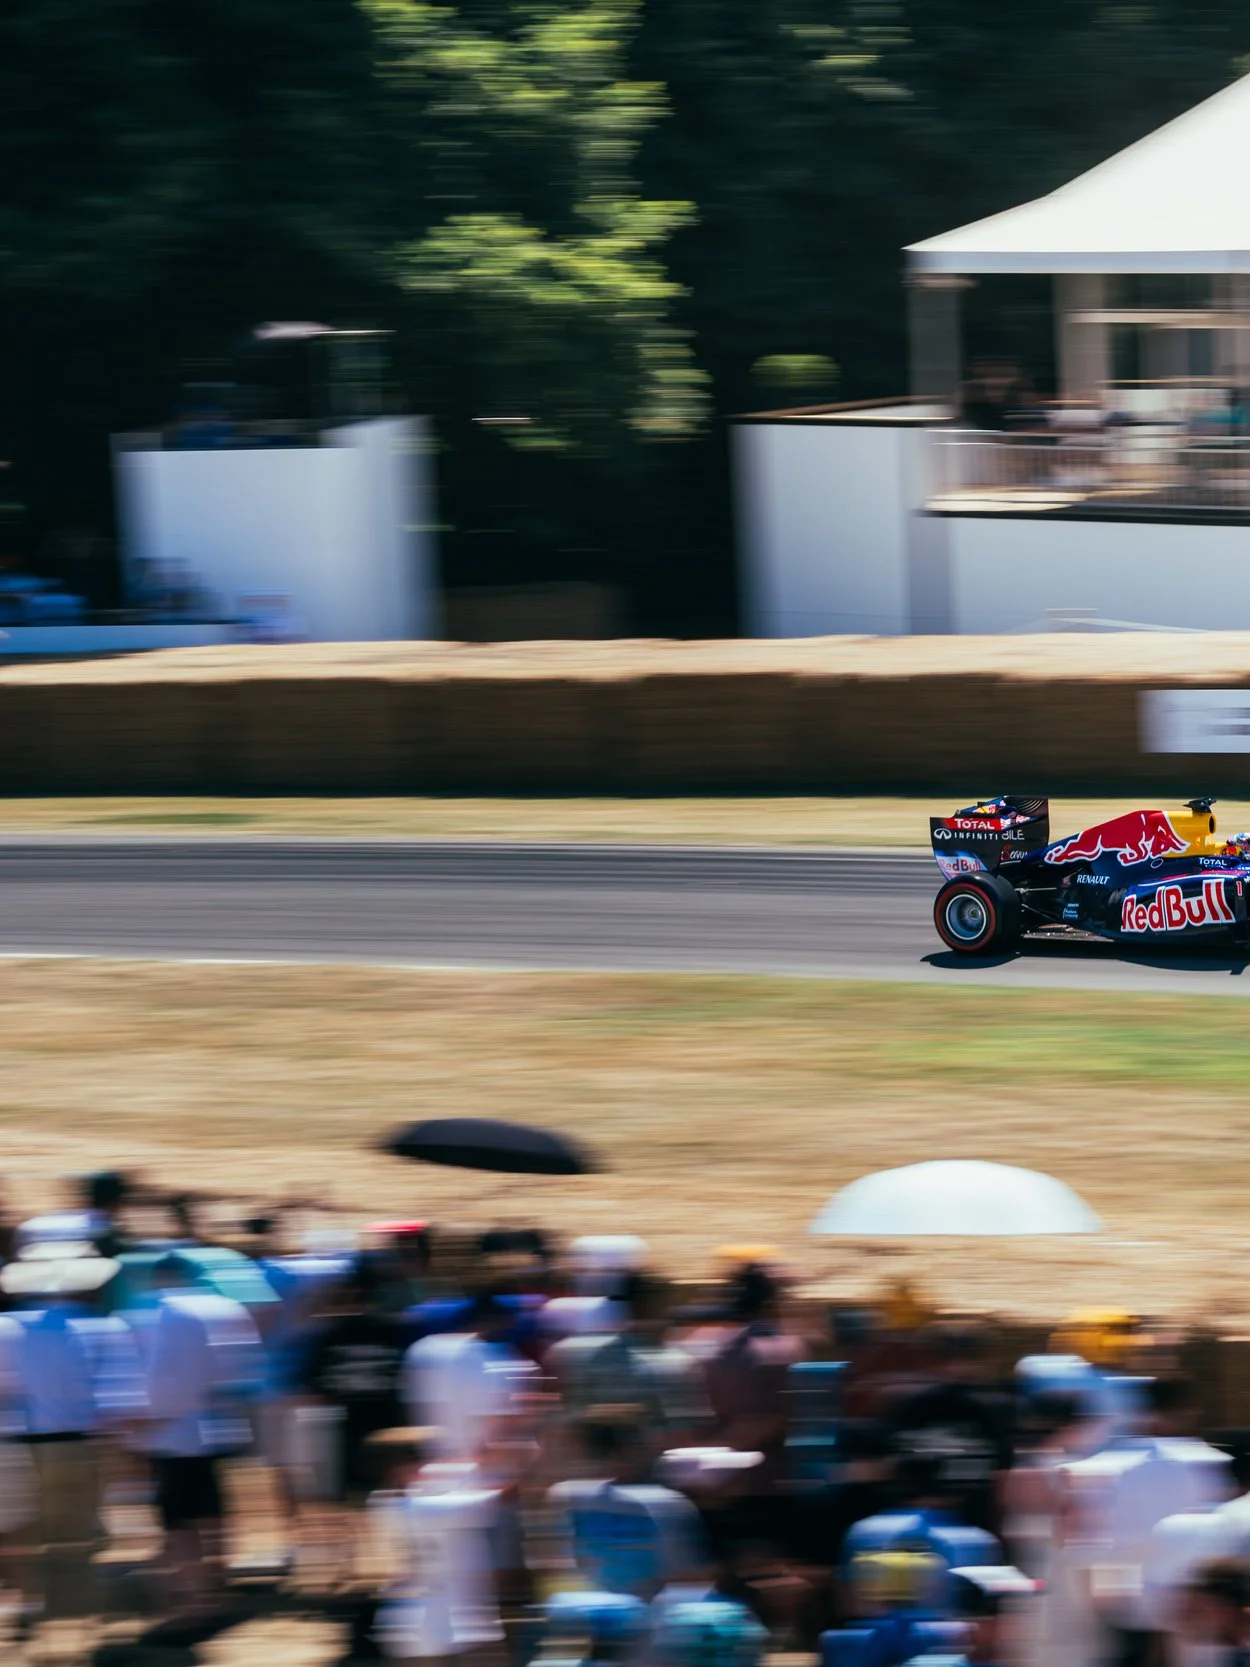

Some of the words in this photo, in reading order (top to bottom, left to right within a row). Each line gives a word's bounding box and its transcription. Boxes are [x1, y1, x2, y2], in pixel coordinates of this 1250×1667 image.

[954, 818, 995, 830] TOTAL
[954, 832, 998, 840] INFINITI
[1199, 857, 1227, 866] TOTAL
[1077, 874, 1110, 885] RENAULT
[1236, 880, 1243, 897] 1
